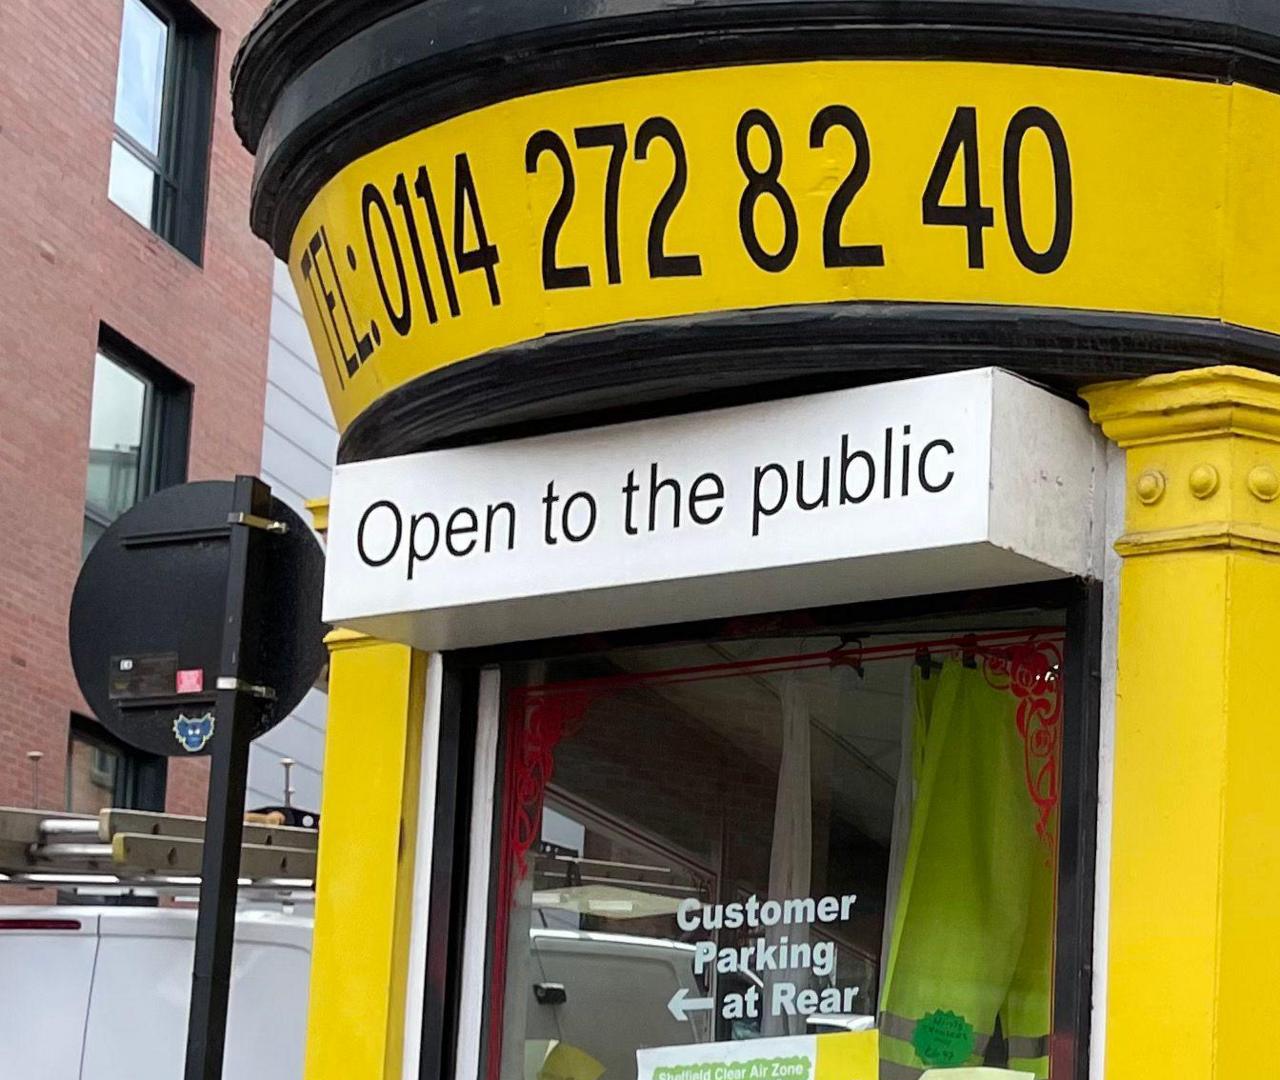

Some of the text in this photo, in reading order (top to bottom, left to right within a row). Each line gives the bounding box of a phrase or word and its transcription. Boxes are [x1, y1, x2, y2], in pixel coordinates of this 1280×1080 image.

[525, 116, 703, 290] 272
[736, 105, 885, 273] 82
[922, 106, 1074, 274] 40
[356, 424, 957, 581] Open to the public
[676, 892, 857, 933] Customer
[694, 939, 836, 978] Parking
[722, 982, 860, 1021] at Rear
[750, 1063, 768, 1078] Air
[772, 1062, 804, 1077] Zone
